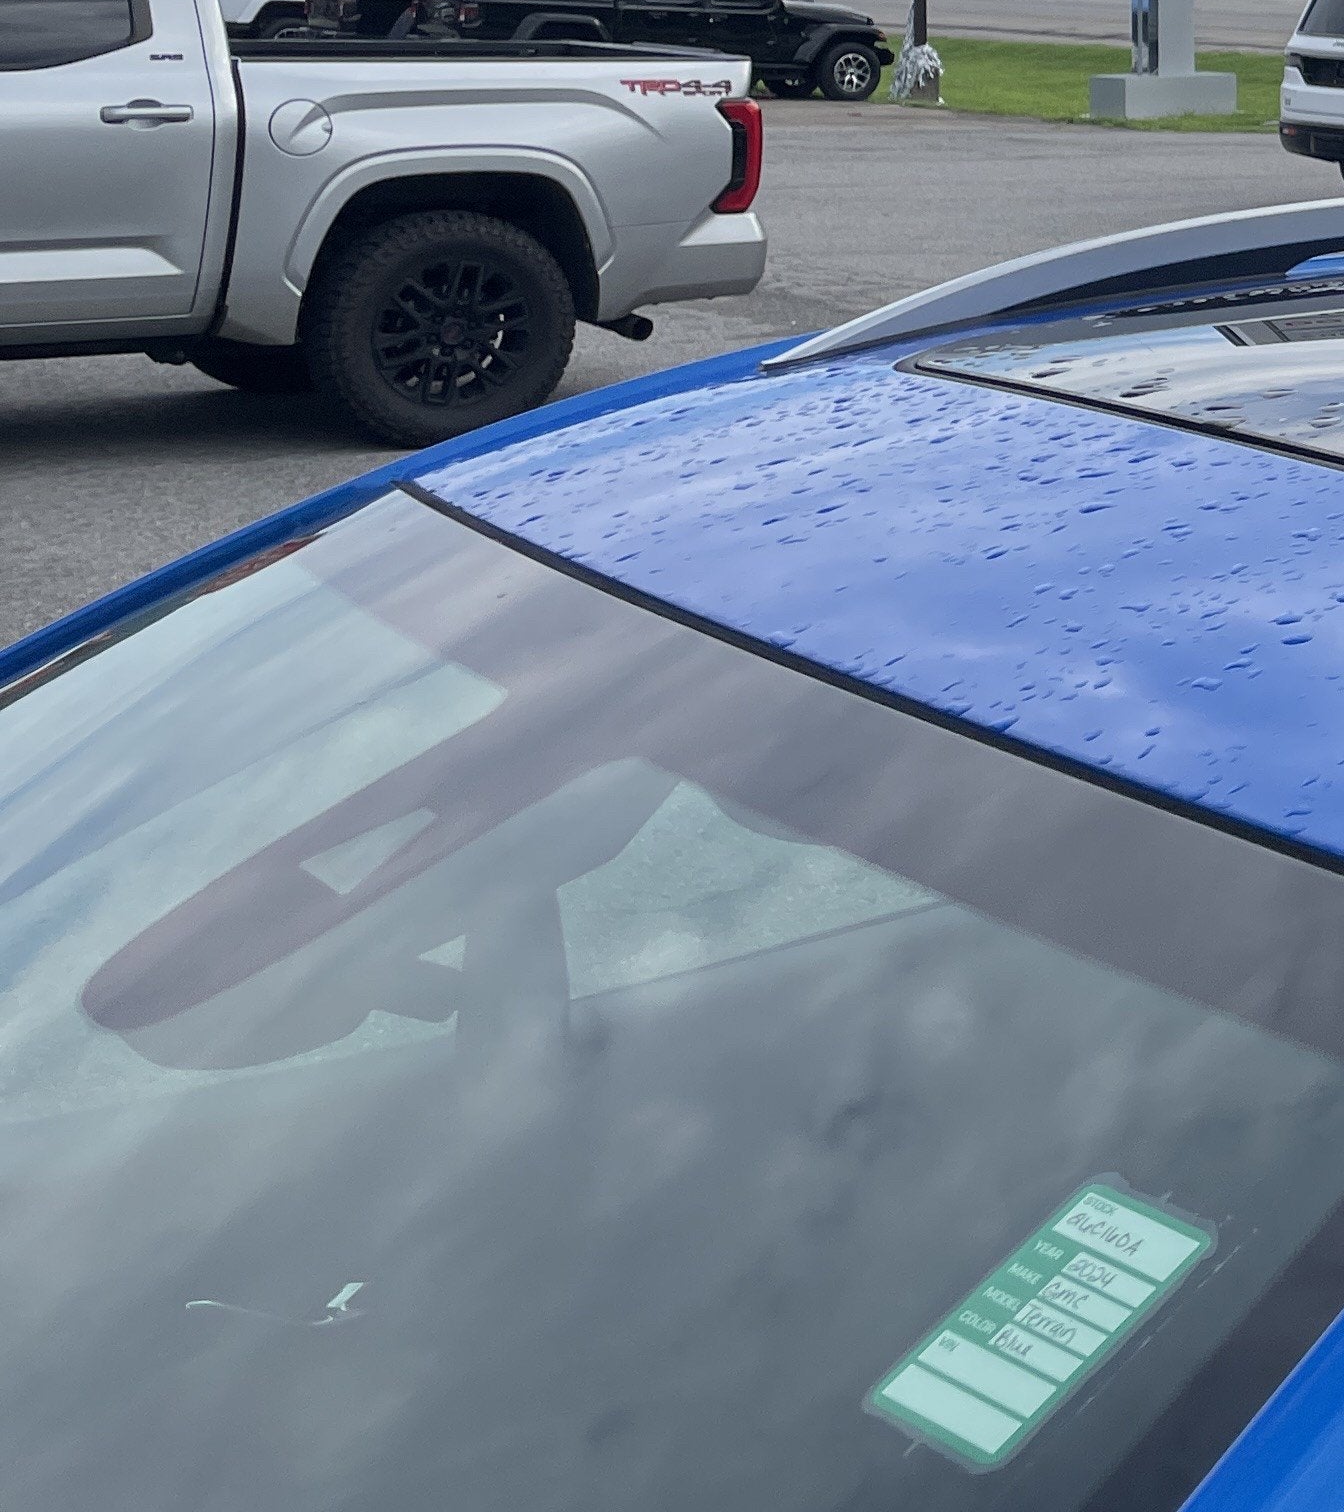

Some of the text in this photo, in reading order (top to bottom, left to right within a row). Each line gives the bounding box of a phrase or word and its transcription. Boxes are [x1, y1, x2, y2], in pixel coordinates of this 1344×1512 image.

[1082, 1195, 1119, 1217] STOCK
[1033, 1239, 1064, 1261] YEAR
[1007, 1262, 1043, 1285] MAKE
[1068, 1258, 1118, 1288] 2024
[982, 1286, 1022, 1312] MODEL
[958, 1309, 997, 1335] COLOR
